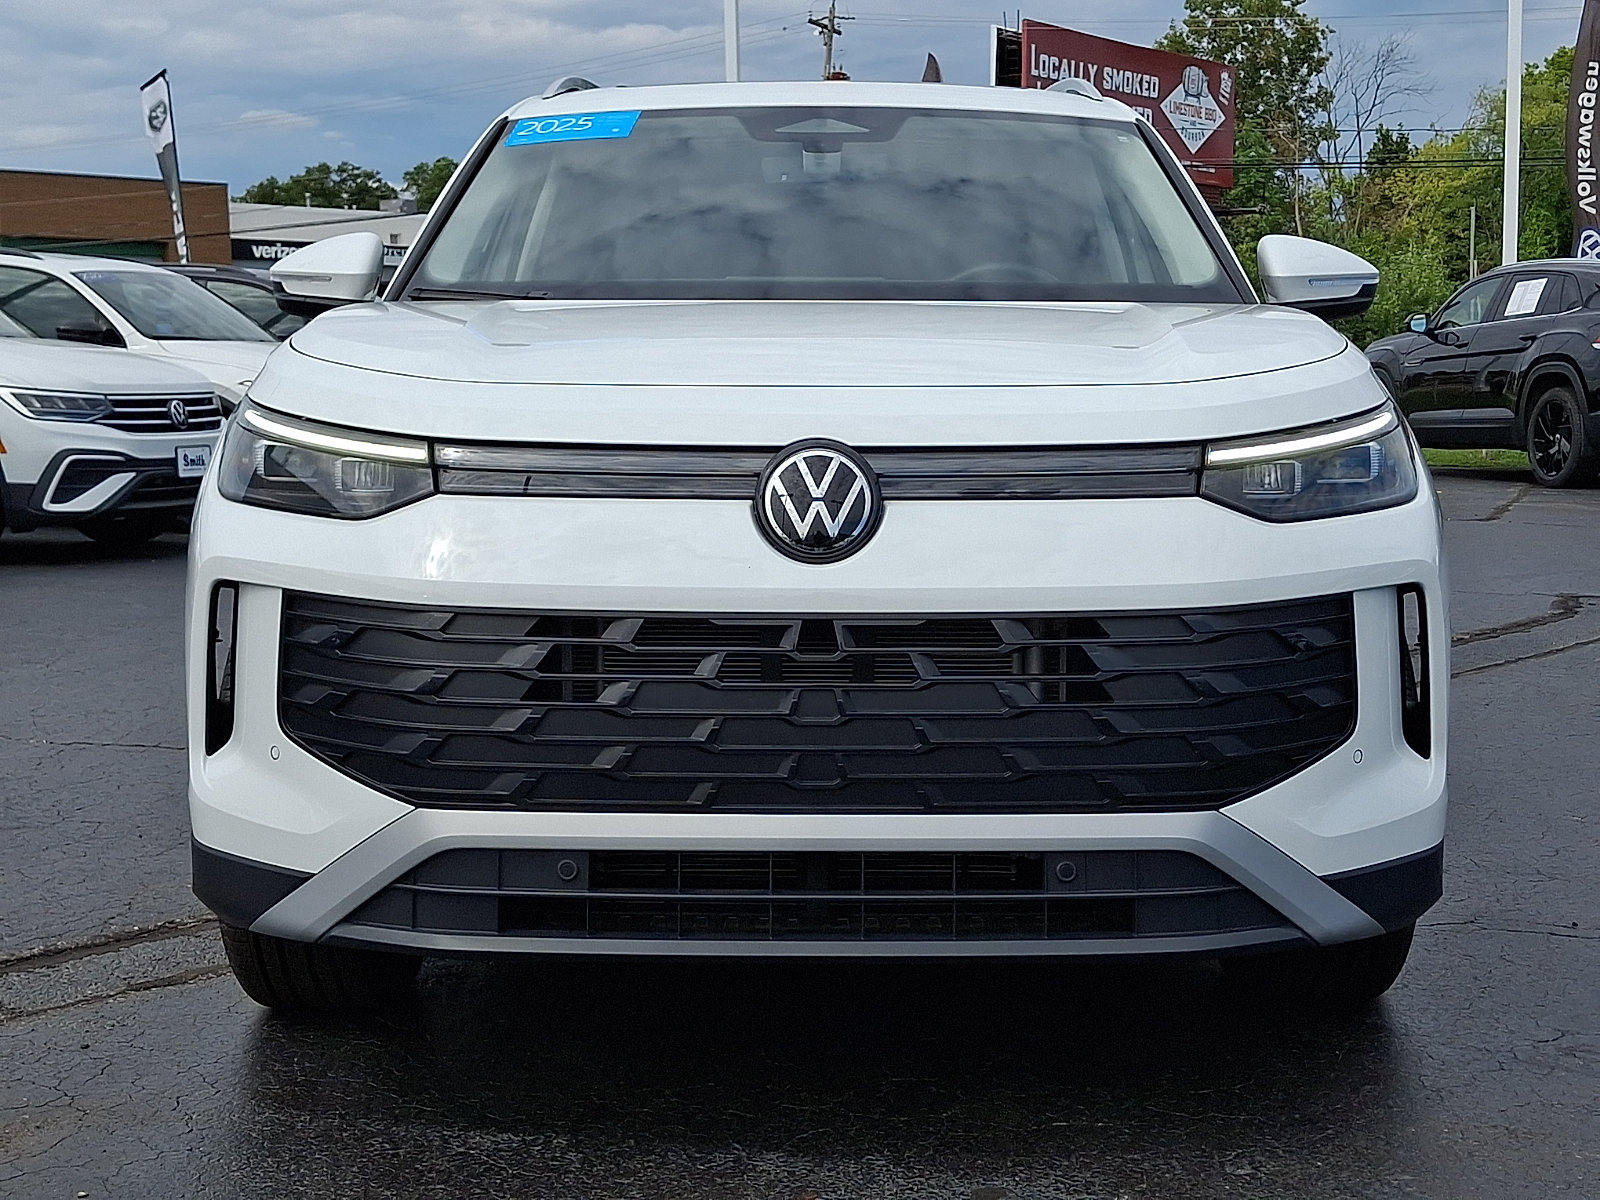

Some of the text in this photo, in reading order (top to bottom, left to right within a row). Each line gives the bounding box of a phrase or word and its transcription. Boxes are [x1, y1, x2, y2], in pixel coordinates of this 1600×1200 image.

[1030, 43, 1160, 98] LOCALLY SMOKED
[516, 116, 596, 136] 2025
[251, 243, 300, 259] veriz
